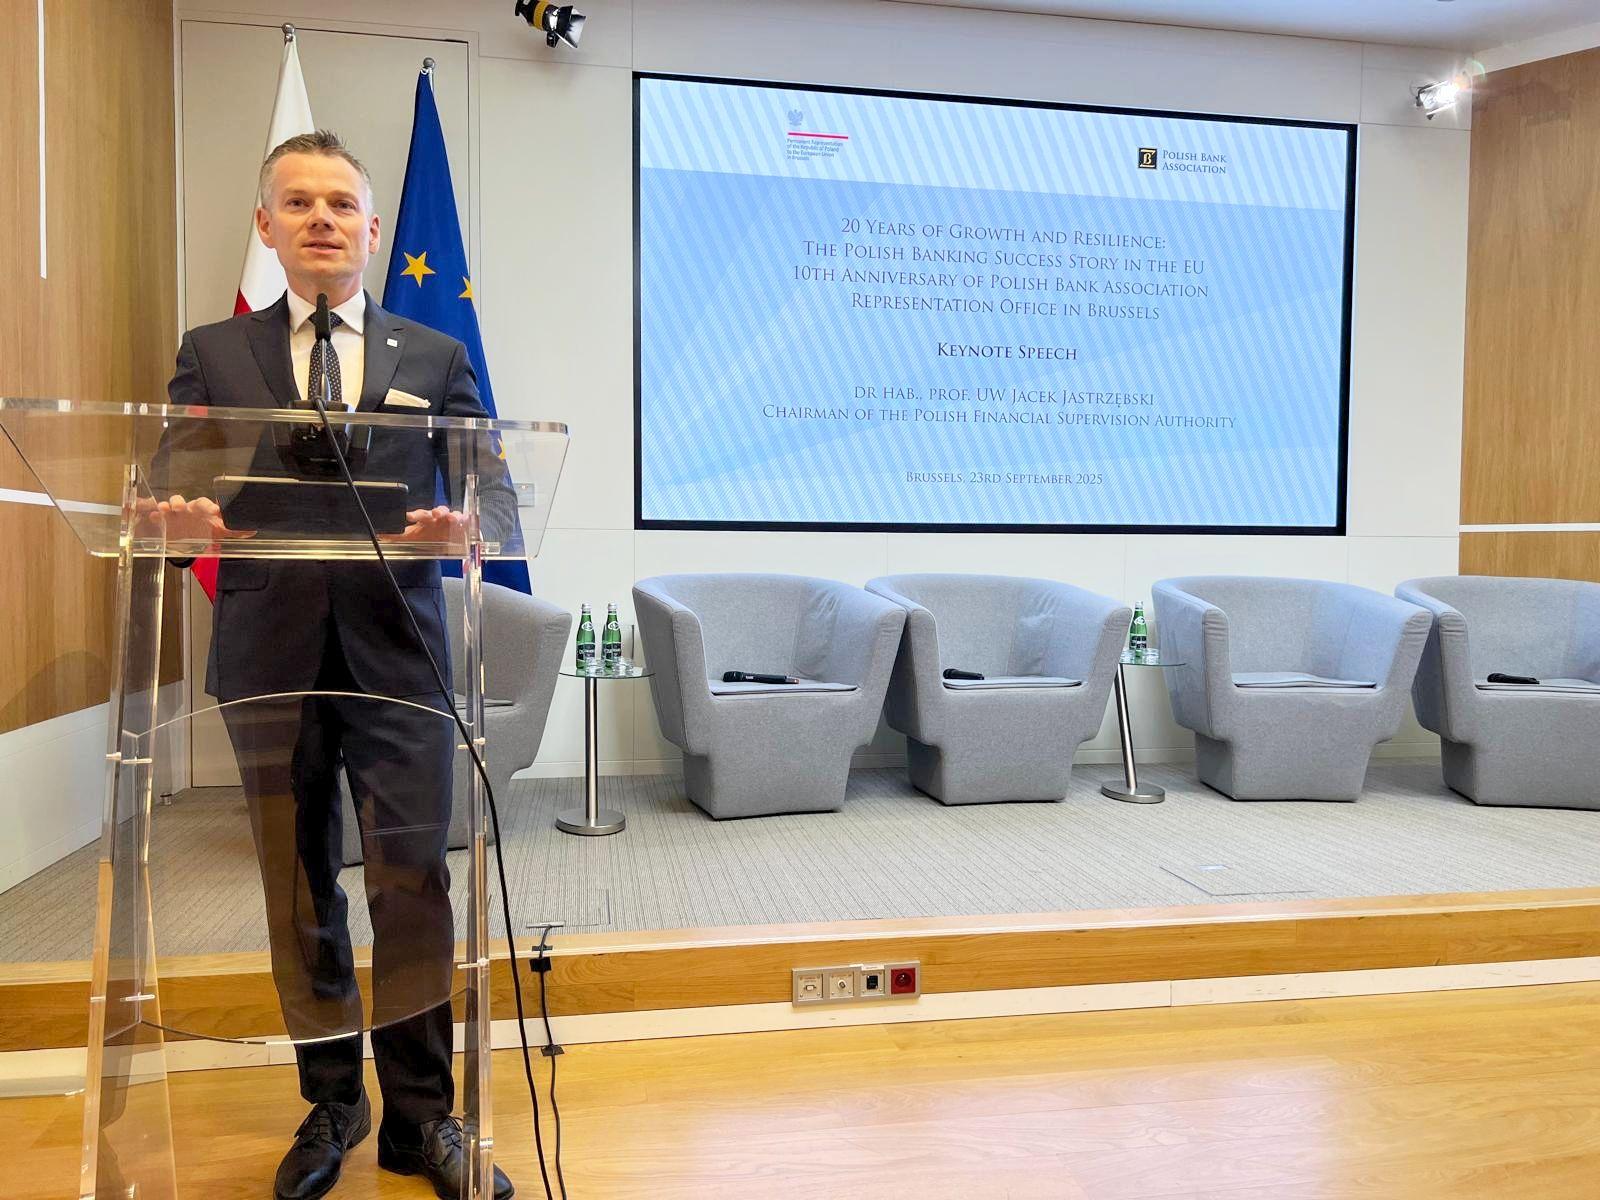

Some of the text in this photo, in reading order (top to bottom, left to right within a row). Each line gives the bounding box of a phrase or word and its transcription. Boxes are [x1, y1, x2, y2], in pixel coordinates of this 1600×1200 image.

[1162, 162, 1226, 174] ASSOCIATION
[1163, 150, 1227, 163] POLISH BANK
[841, 217, 1166, 249] 20 YEARS OF GROWTH AND RESILIENCE:
[802, 240, 1204, 275] THE POLISH BANKING SUCCESS STORY IN THE EU
[794, 265, 1208, 298] 10TH ANNIVERSARY OF POLISH BANK ASSOCIATION
[852, 292, 1160, 320] REPRESENTATION OFFICE IN BRUSSELS
[937, 342, 1077, 360] KEYNOTE SPEECH
[855, 386, 877, 399] DR
[929, 388, 970, 401] PROF.
[977, 387, 1006, 401] UW
[1012, 388, 1057, 405] JACEK
[1062, 389, 1154, 408] JASTRZĘBSKI
[762, 404, 1236, 429] CHAIRMAN OF THE POLISH FINANCIAL SUPERVISION AUTHORITY
[970, 471, 1001, 484] 23RD
[1006, 472, 1072, 485] SEPTEMBER
[1076, 473, 1103, 485] 2025
